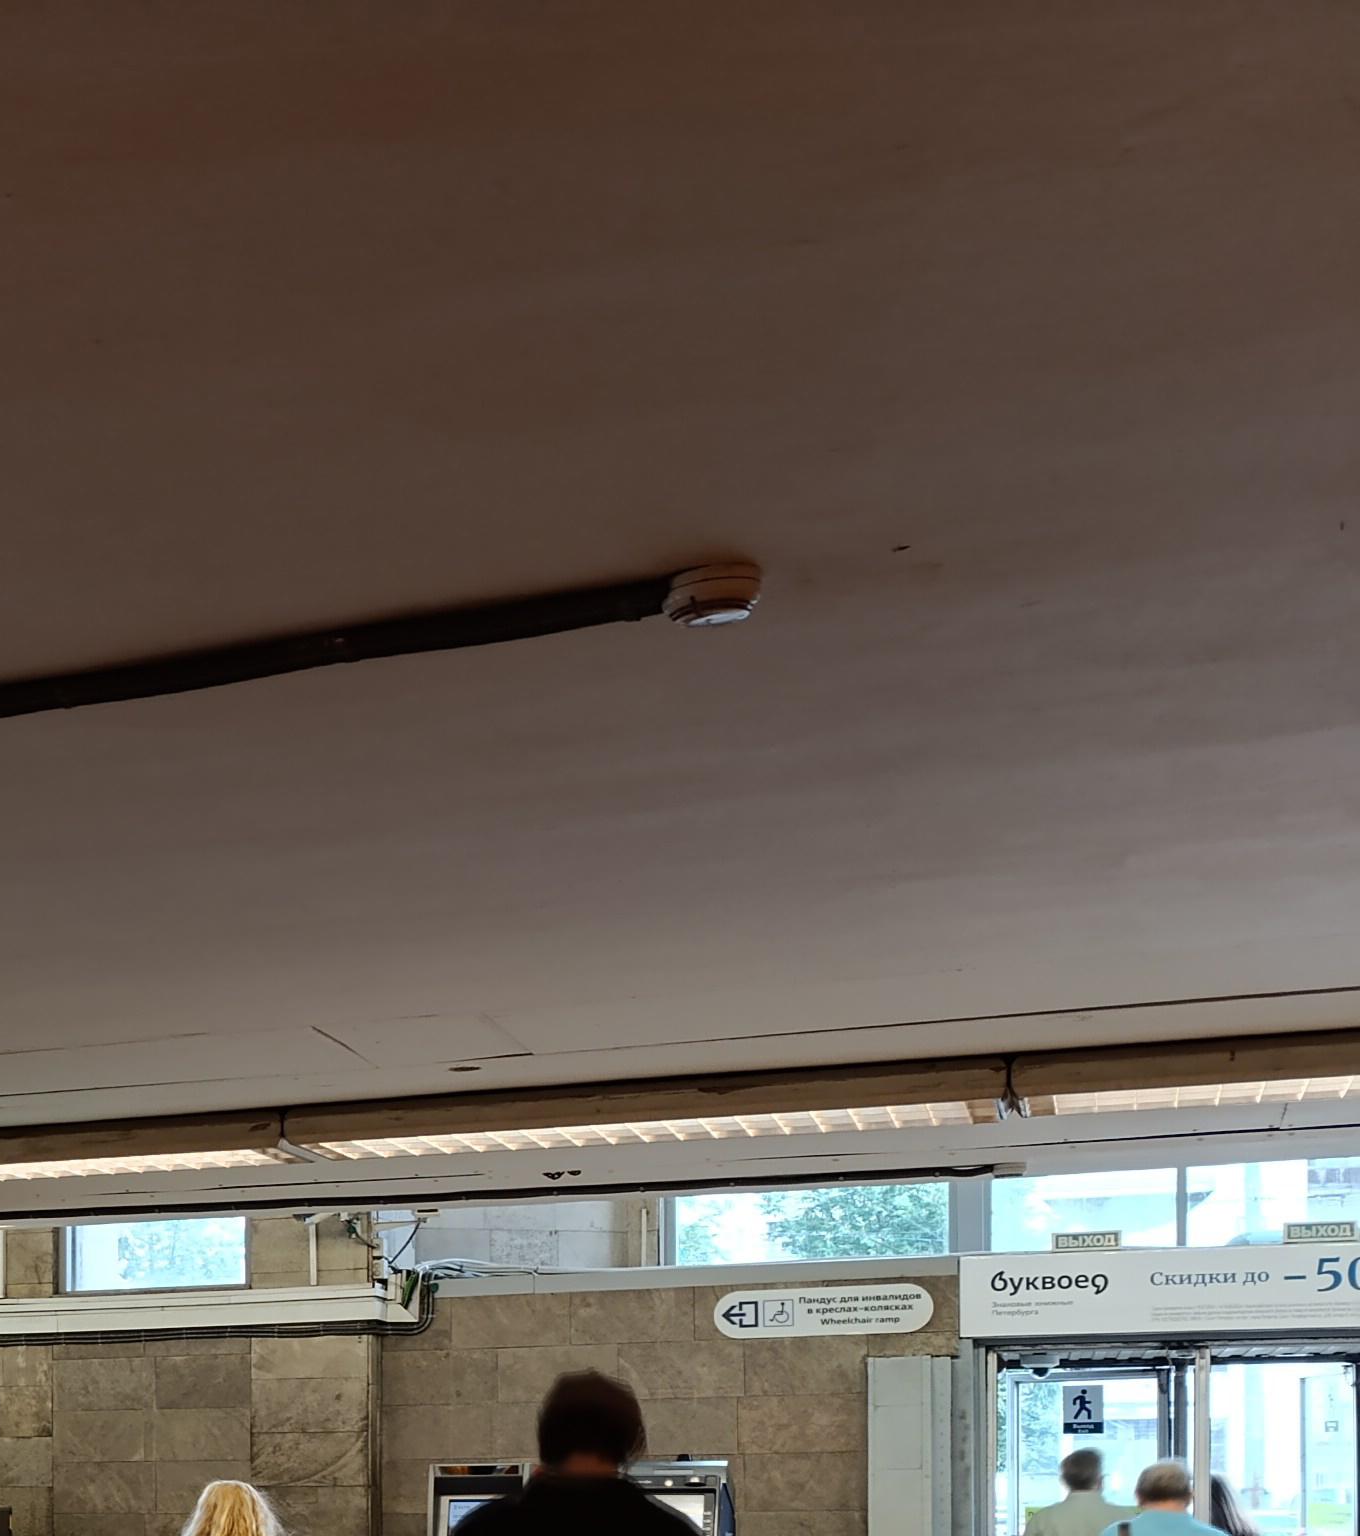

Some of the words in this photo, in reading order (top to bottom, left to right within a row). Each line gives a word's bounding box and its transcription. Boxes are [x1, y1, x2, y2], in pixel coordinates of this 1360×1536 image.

[1290, 1224, 1352, 1239] ВЫХОД
[1057, 1234, 1117, 1248] ВЫХОД
[1150, 1271, 1236, 1287] Скидки
[1242, 1270, 1270, 1285] до
[799, 1294, 837, 1306] Пандус
[839, 1294, 859, 1304] для
[862, 1292, 922, 1303] инвалидов
[815, 1303, 914, 1315] креслах-колясках
[820, 1315, 872, 1326] Wheelchair
